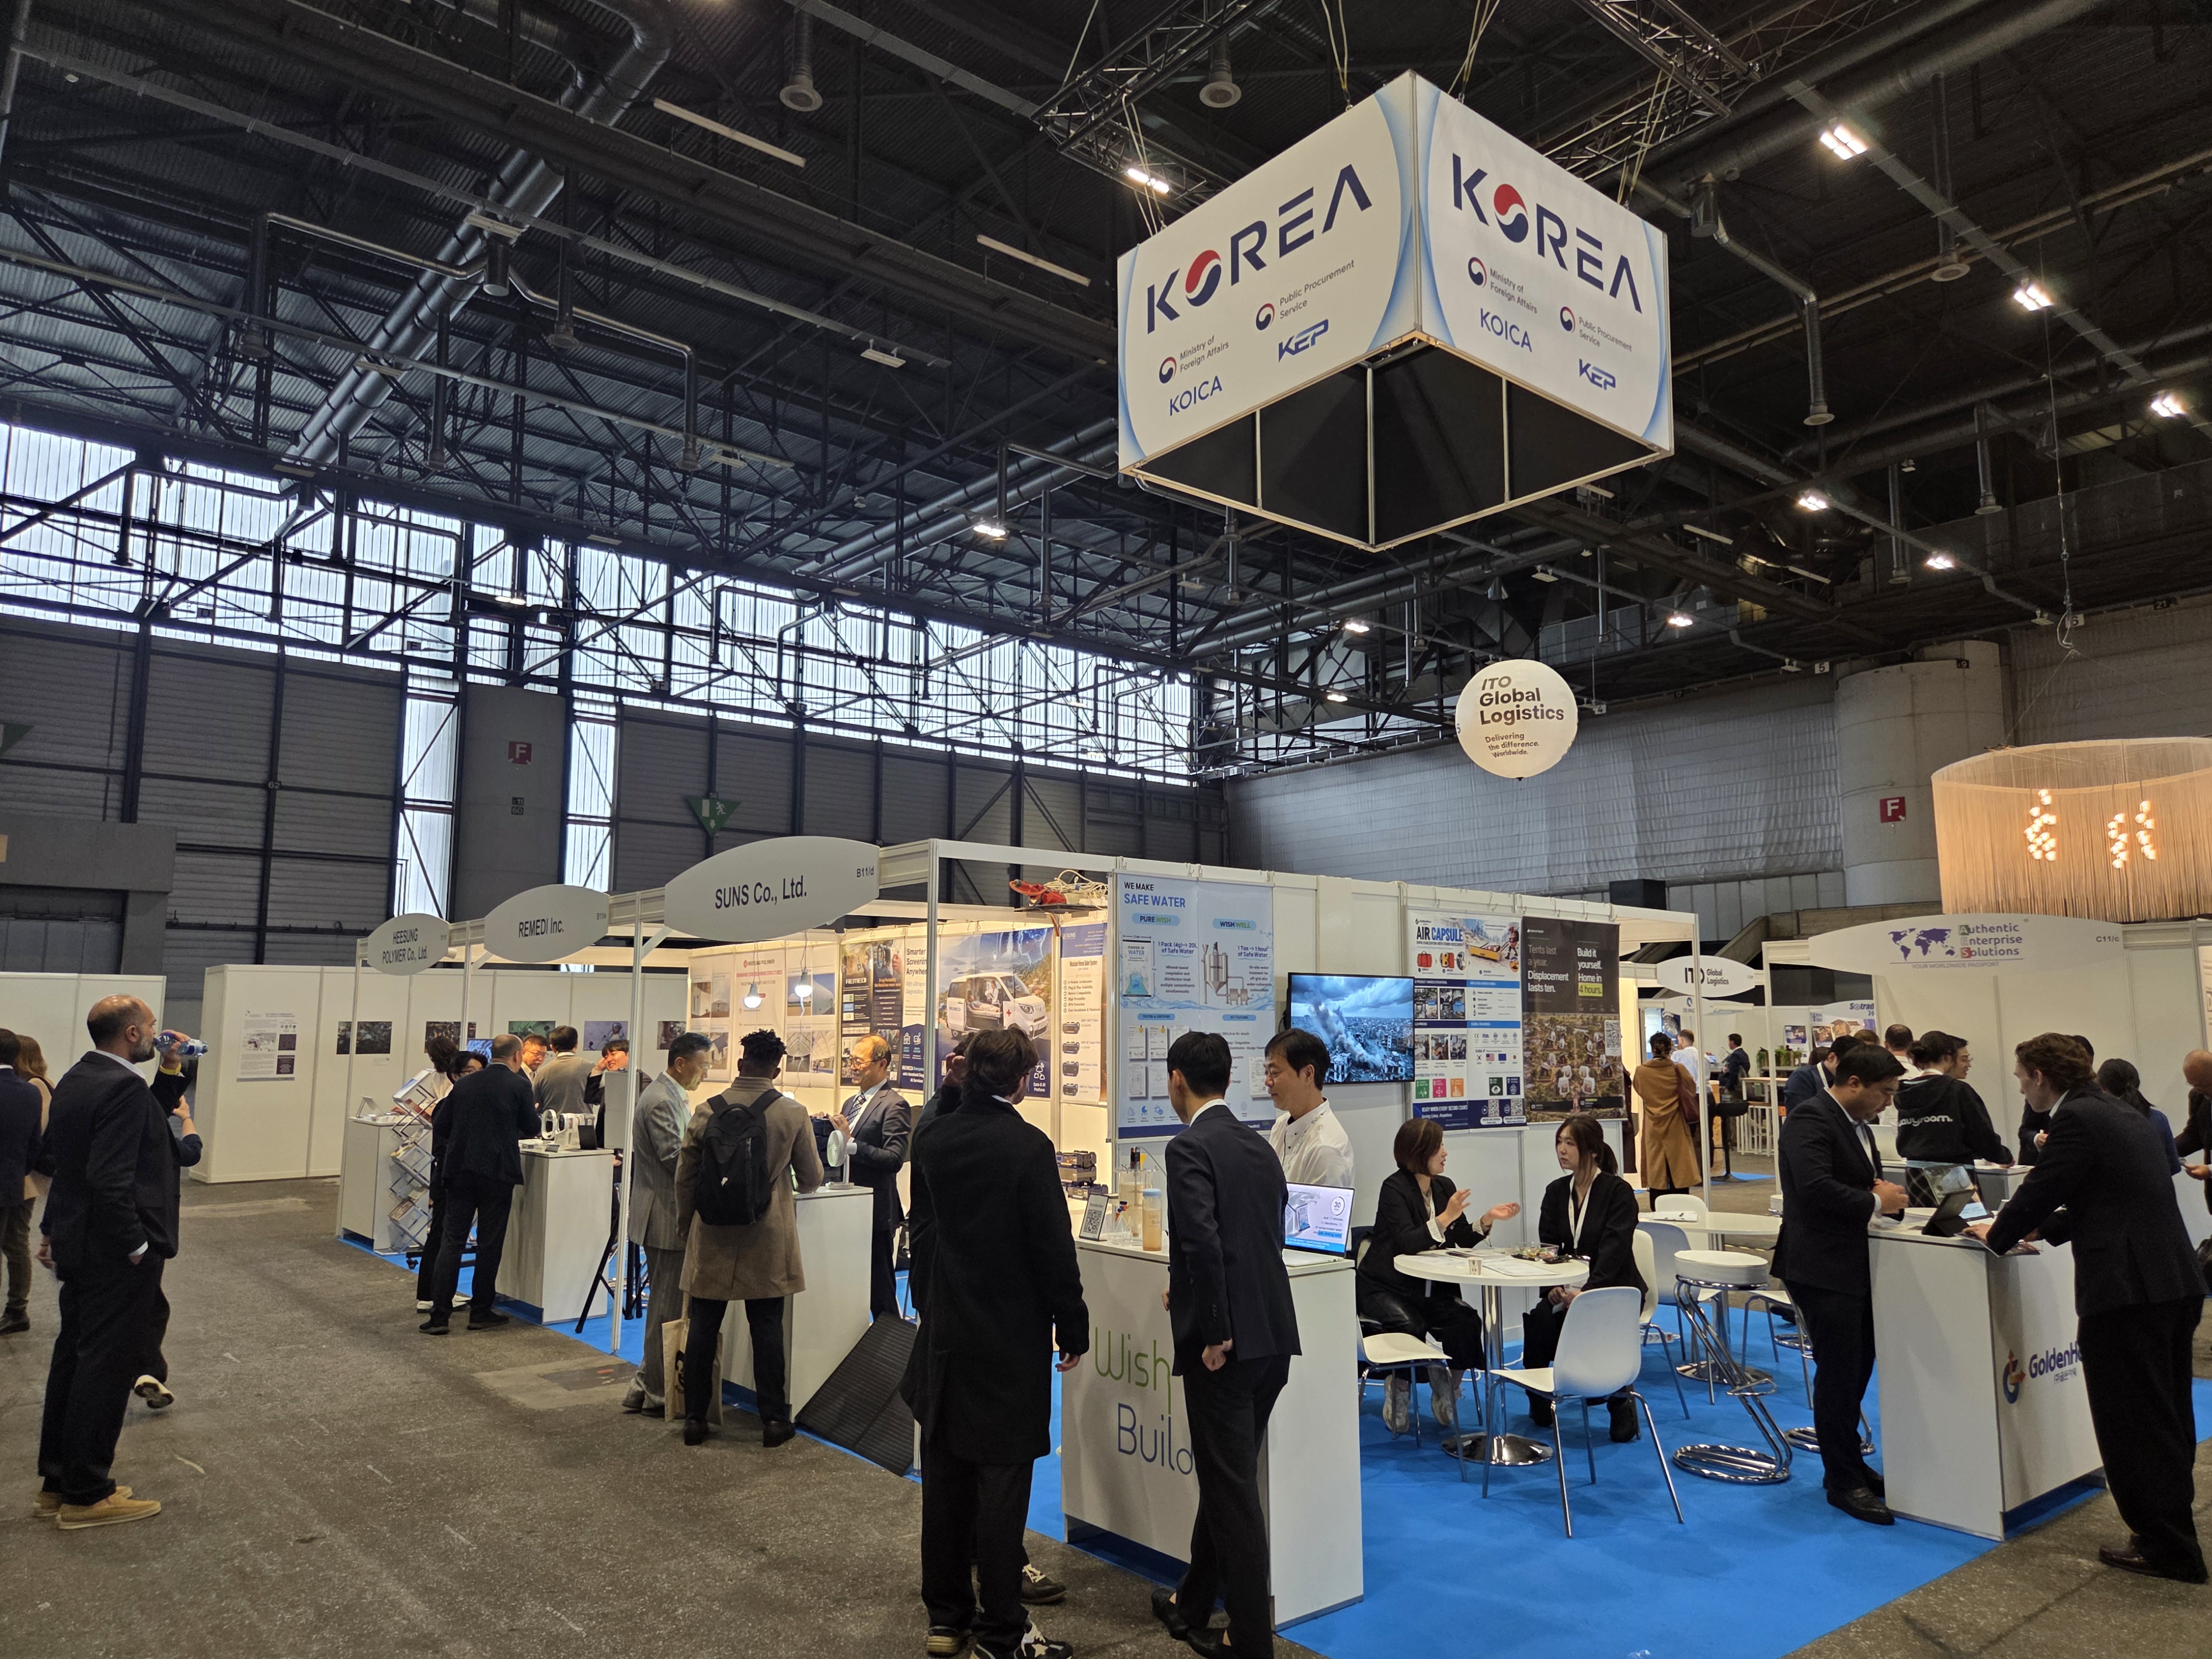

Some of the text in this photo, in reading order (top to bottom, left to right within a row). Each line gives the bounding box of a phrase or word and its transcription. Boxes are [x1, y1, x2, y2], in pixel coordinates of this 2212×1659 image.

[1452, 153, 1642, 314] KOREA
[1147, 164, 1372, 335] KOREA
[1280, 259, 1355, 307] Public Procurement
[1490, 268, 1524, 294] Ministry of
[1490, 282, 1537, 314] Foreign Affairs
[1280, 300, 1308, 319] Service
[1480, 307, 1532, 353] KOICA
[1579, 316, 1632, 352] Public Procurement
[1279, 319, 1329, 363] KEP
[1579, 330, 1600, 347] Service
[1180, 335, 1215, 361] Ministry of
[1180, 342, 1229, 373] Foreign Affairs
[1578, 358, 1616, 390] KEP
[1170, 375, 1223, 416] KOICA
[2070, 615, 2079, 626] 6
[1819, 662, 1825, 672] 5
[1481, 676, 1511, 691] ITO
[1479, 687, 1541, 707] Global
[1480, 704, 1564, 726] Logistics
[1485, 732, 1525, 743] Delivering
[1501, 740, 1540, 748] difference.
[516, 744, 528, 758] F
[1491, 749, 1528, 758] Worldwide.
[268, 781, 280, 789] 62
[1887, 800, 1900, 817] F
[857, 867, 874, 878] B11/d
[715, 875, 807, 909] SUNS Co., Ltd.
[1124, 881, 1154, 891] WE MAKE
[1124, 893, 1186, 908] SAFE WATER
[519, 917, 564, 938] REMEDI Inc.
[1416, 926, 1463, 942] AIR CAPSULE
[1959, 922, 2020, 935] Authentic
[393, 928, 418, 945] HEESUNG
[1961, 935, 2023, 946] Enterprise
[382, 948, 406, 964] POLYMER
[418, 945, 428, 959] Ltd.
[1527, 945, 1557, 955] Tents last
[1577, 948, 1597, 958] Build it
[1961, 947, 2020, 958] Solutions
[1533, 959, 1548, 968] year.
[1578, 961, 1602, 971] yourself.
[1528, 970, 1569, 982] Displacement
[1578, 973, 1602, 982] Home in
[1707, 977, 1729, 987] Logistics
[1528, 983, 1556, 993] lasts ten.
[1584, 985, 1603, 994] hours.
[1094, 1327, 1172, 1415] Wish
